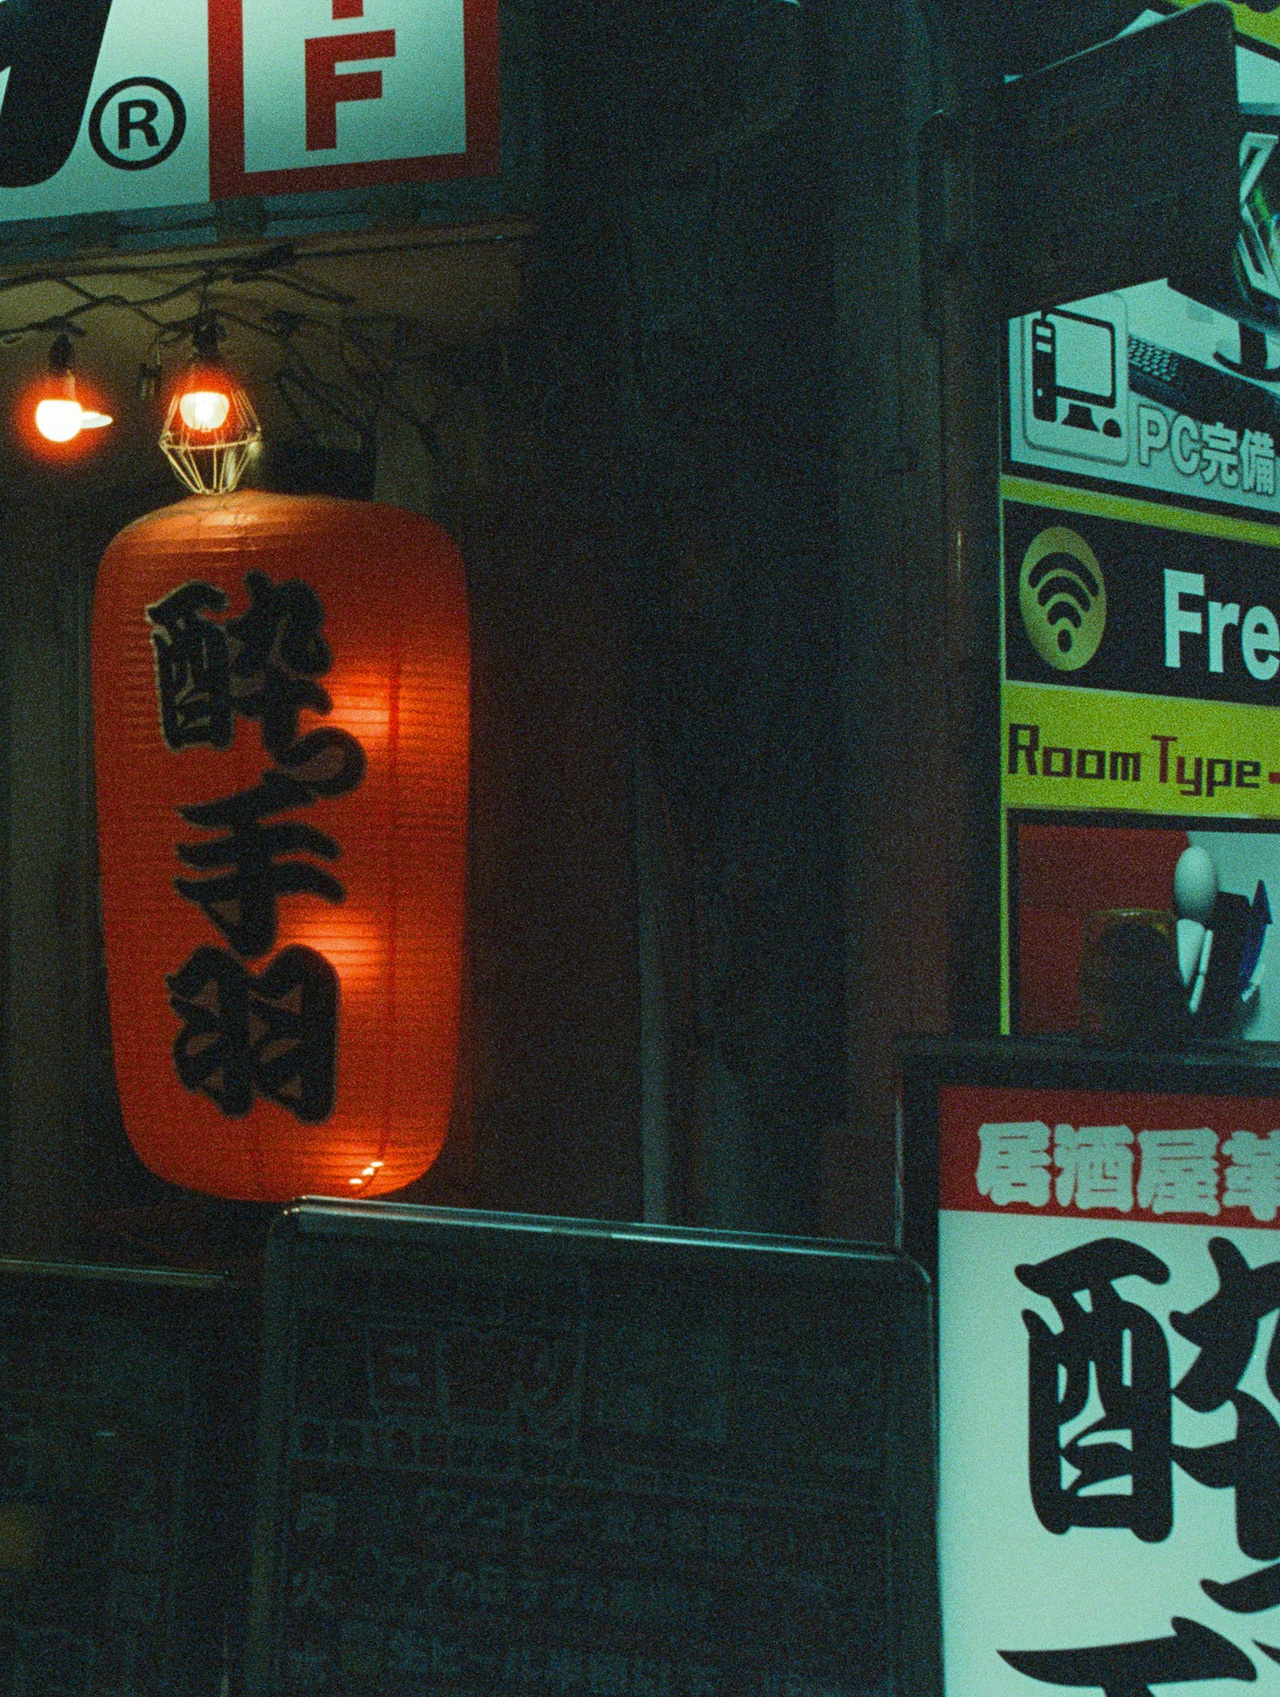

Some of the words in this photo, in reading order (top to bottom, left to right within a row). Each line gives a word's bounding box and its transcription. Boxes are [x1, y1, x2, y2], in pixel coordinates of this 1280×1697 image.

[1137, 403, 1276, 497] PC完備
[1007, 722, 1141, 782] Room
[1150, 734, 1261, 797] Type
[146, 567, 368, 1125] 酔っ手羽
